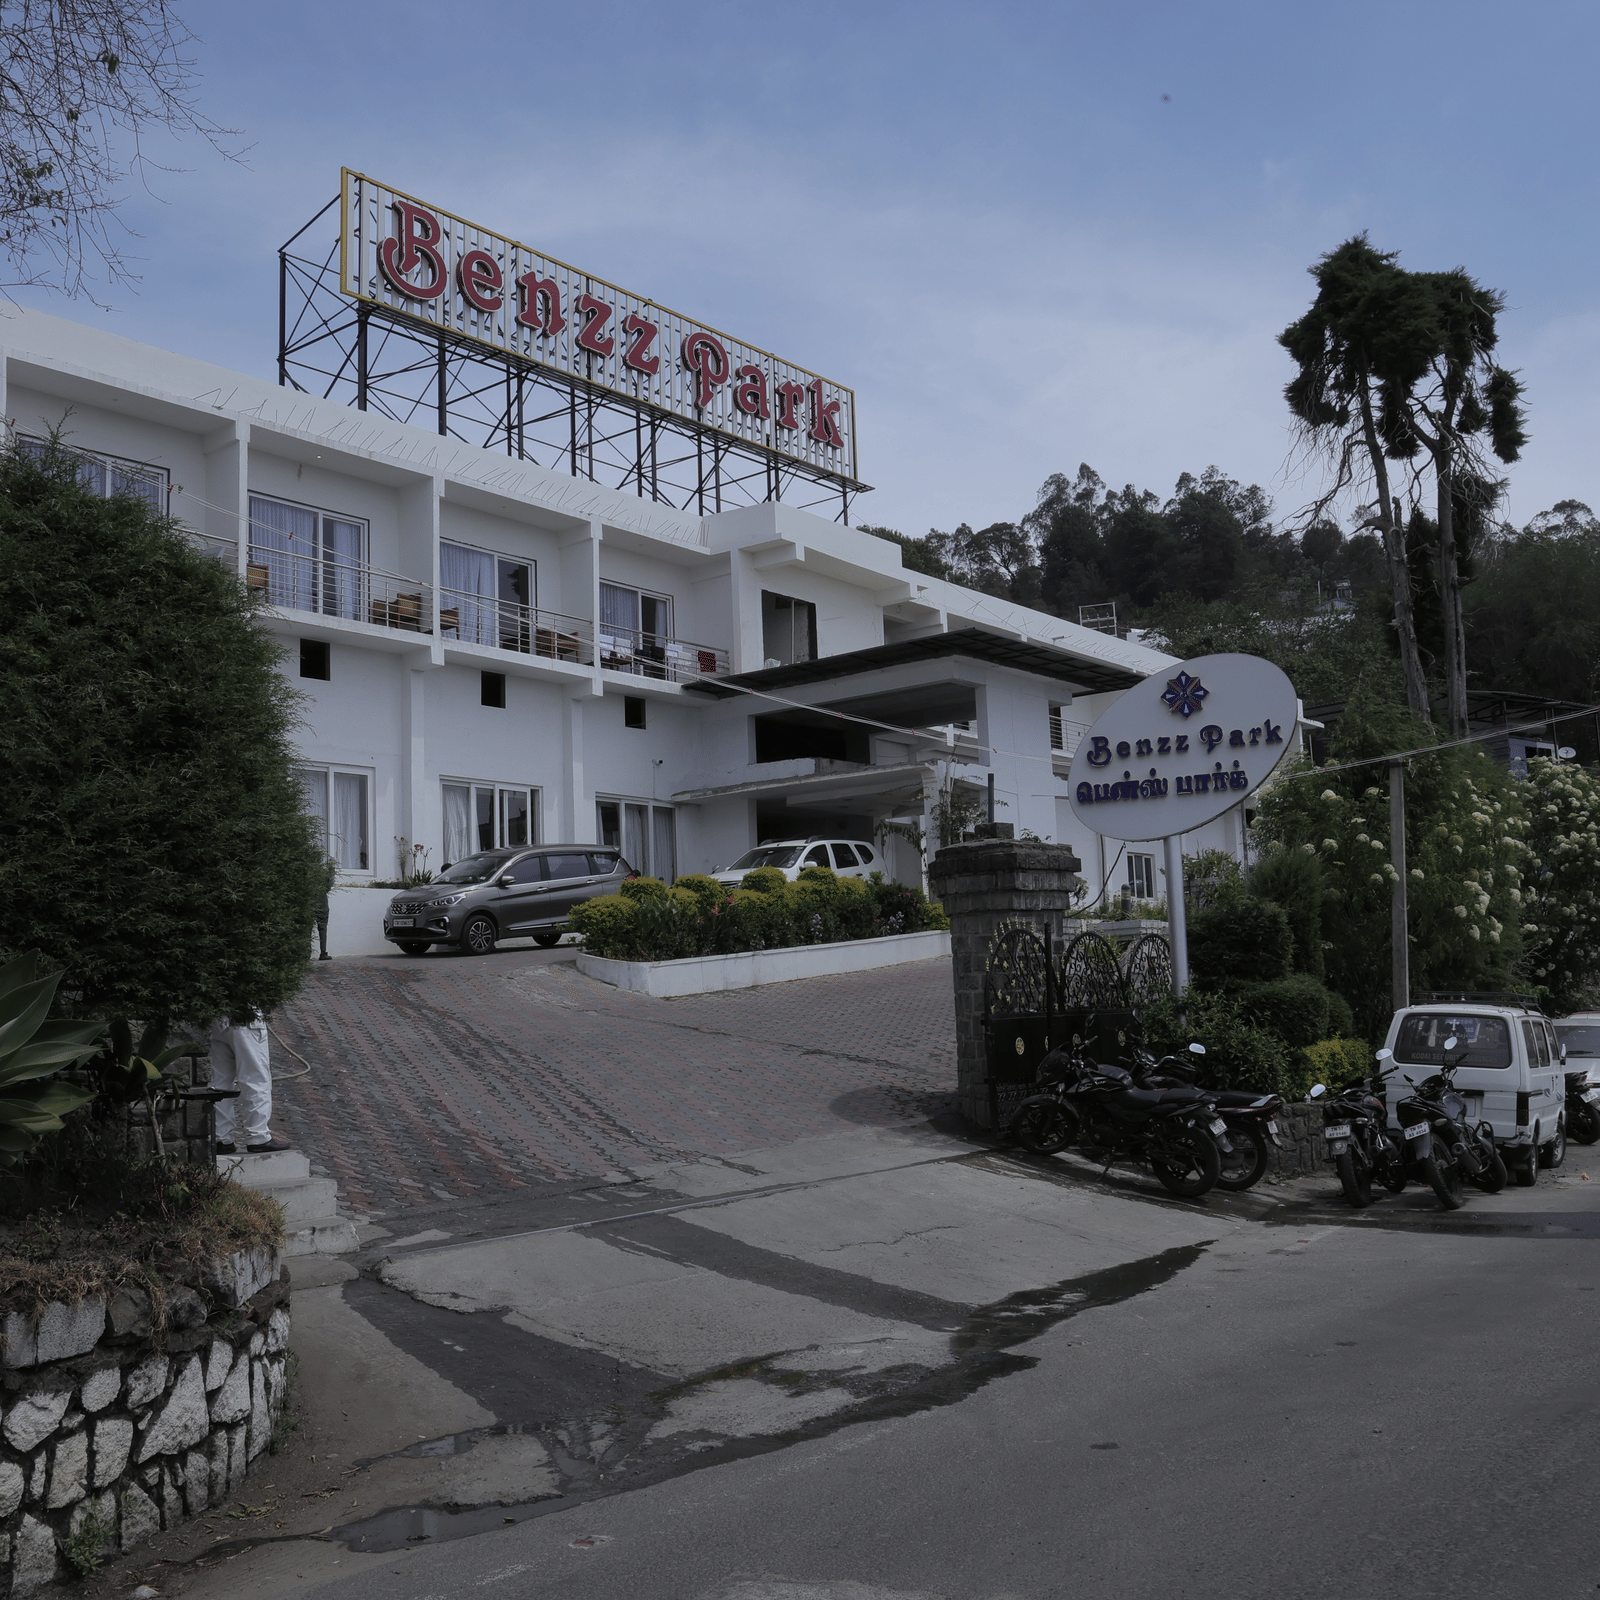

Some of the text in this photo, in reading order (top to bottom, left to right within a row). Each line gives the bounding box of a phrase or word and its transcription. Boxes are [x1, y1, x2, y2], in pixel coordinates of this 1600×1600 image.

[377, 199, 844, 449] Benzz Park
[1086, 718, 1283, 767] Benzz Park
[1076, 759, 1248, 804] பென்ஸ் பார்க்
[1411, 1052, 1431, 1060] KODAI
[1432, 1052, 1463, 1061] SECURIT
